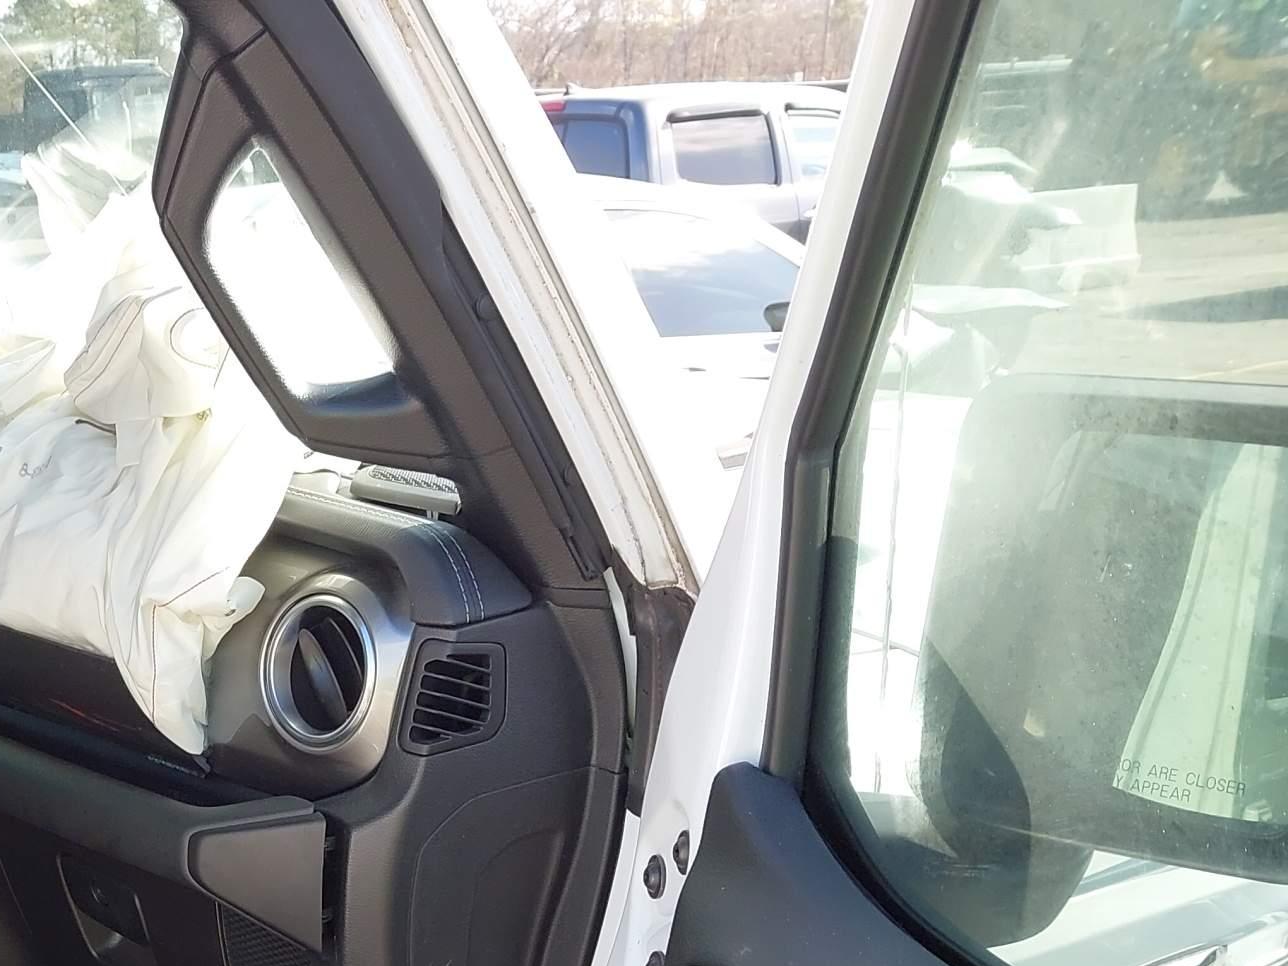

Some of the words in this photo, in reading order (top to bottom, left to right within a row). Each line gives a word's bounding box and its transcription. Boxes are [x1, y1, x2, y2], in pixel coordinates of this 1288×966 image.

[1130, 779, 1191, 802] APPEAR
[1148, 764, 1179, 782] ARE
[1185, 772, 1246, 796] CLOSER
